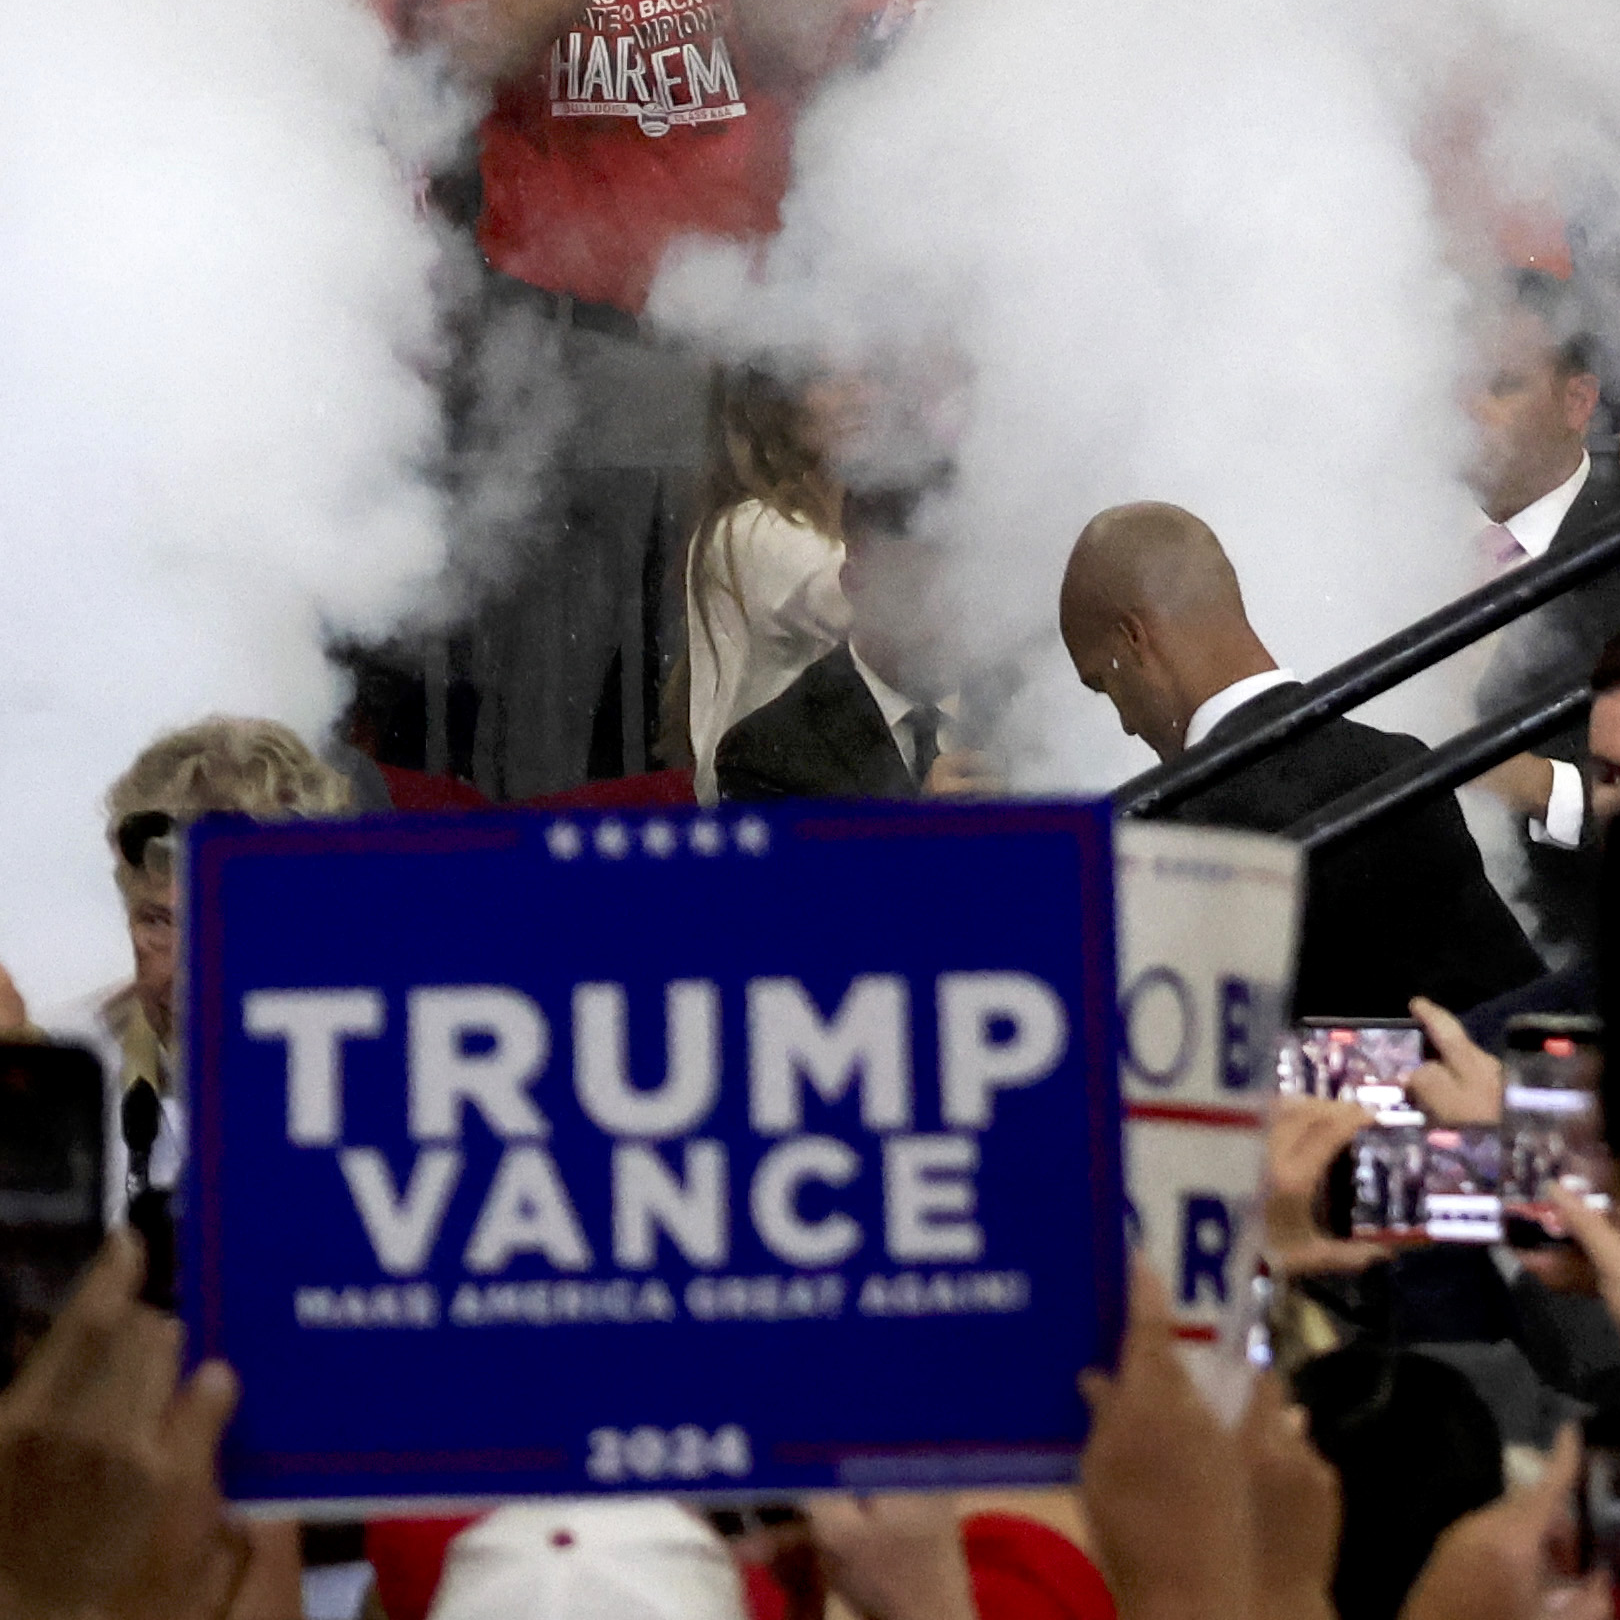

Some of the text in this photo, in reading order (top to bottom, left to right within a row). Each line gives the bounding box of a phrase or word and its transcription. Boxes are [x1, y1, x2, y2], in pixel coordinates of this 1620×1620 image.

[549, 32, 741, 113] HAREM
[240, 970, 1069, 1149] TRUMP
[338, 1136, 985, 1275] VANCE
[295, 1285, 441, 1329] MAKE
[450, 1281, 674, 1327] AMERICA
[684, 1277, 845, 1321] GREAT
[585, 1424, 751, 1482] 2024
